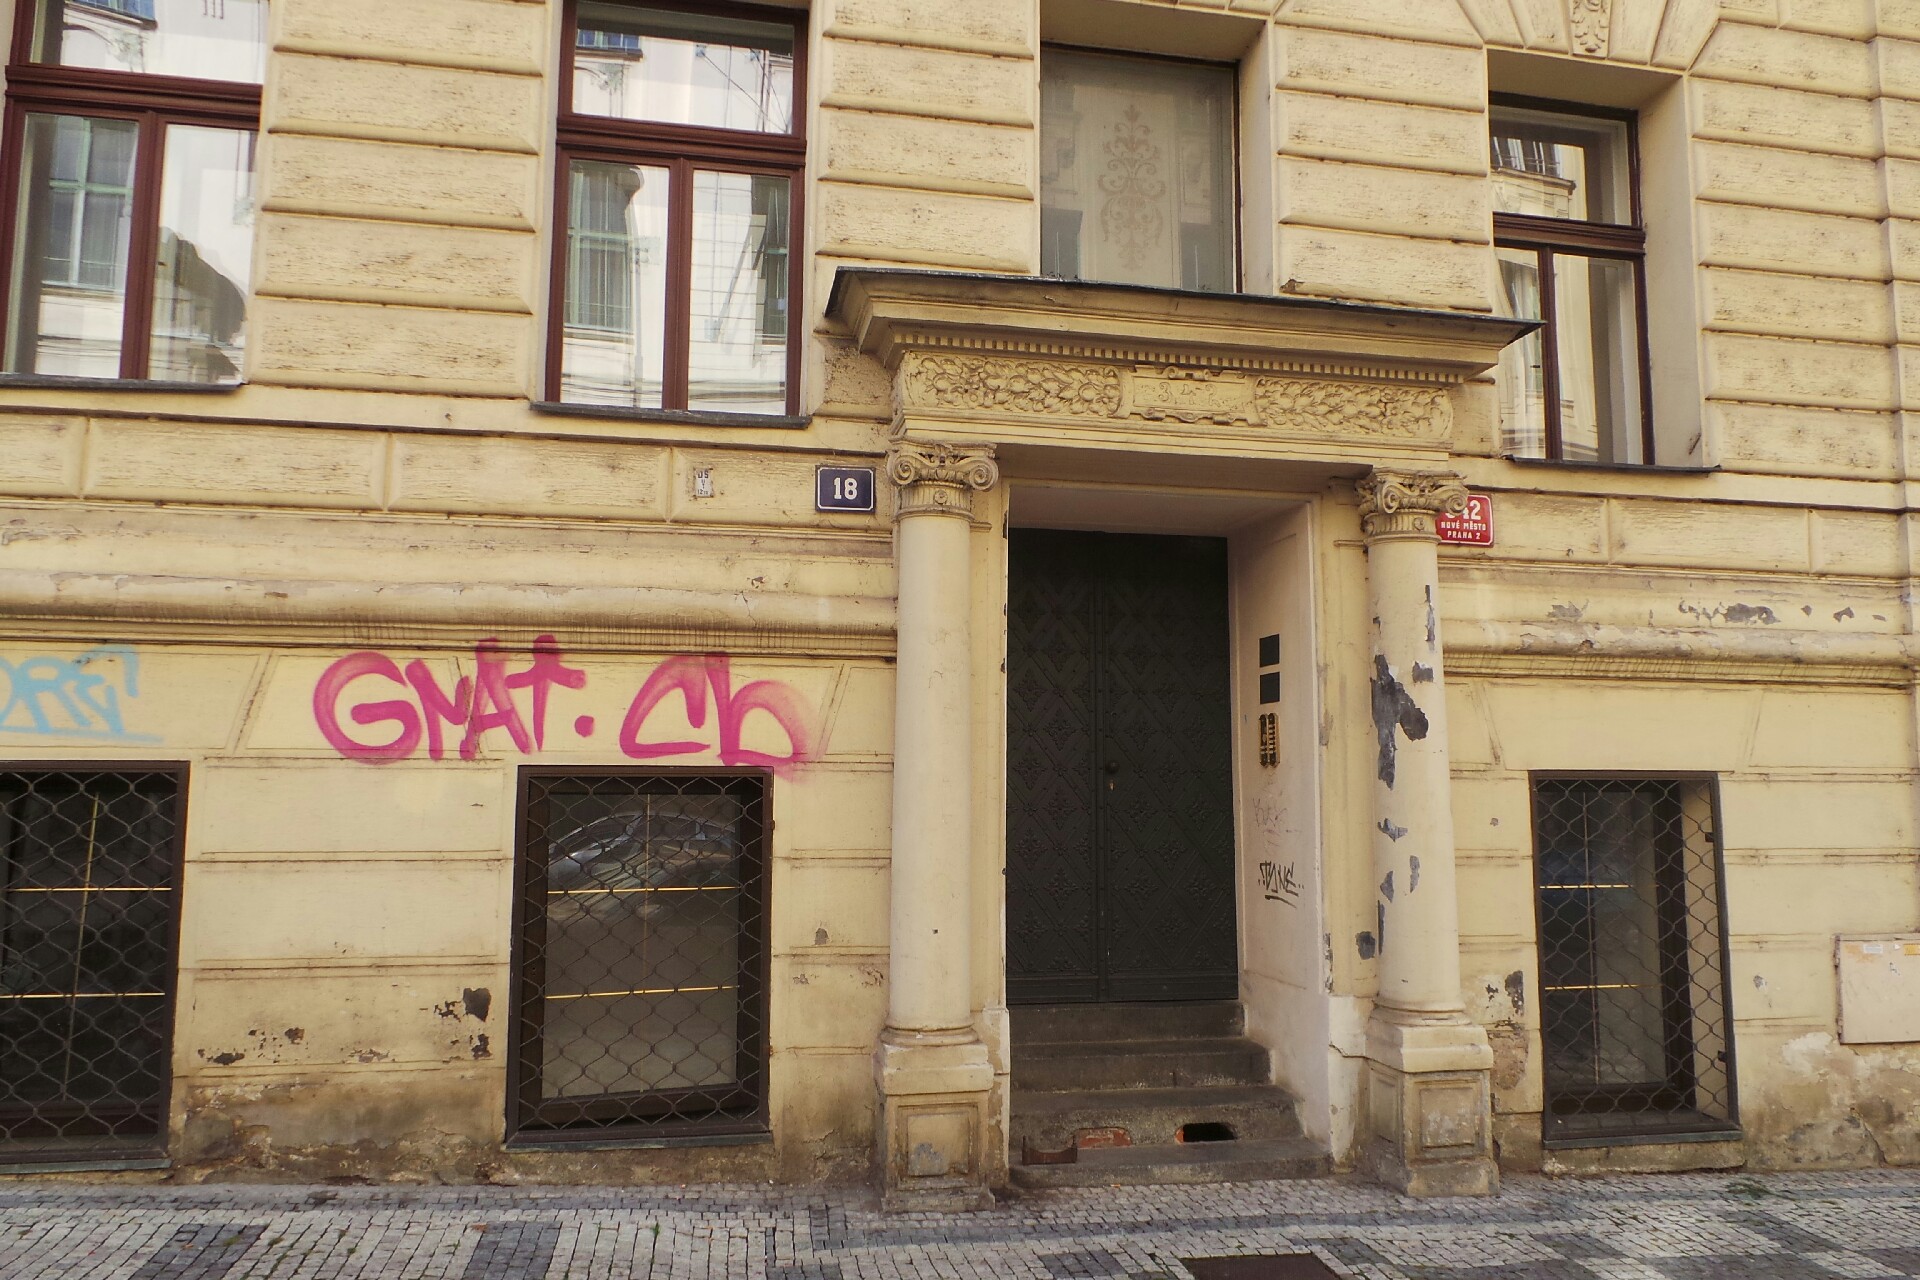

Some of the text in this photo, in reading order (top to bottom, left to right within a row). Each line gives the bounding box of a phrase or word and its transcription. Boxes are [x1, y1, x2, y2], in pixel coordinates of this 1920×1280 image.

[834, 477, 858, 500] 18
[1445, 500, 1482, 520] 42
[1441, 520, 1487, 531] NOVÉ MĚSTO
[1447, 531, 1472, 539] PRAHA
